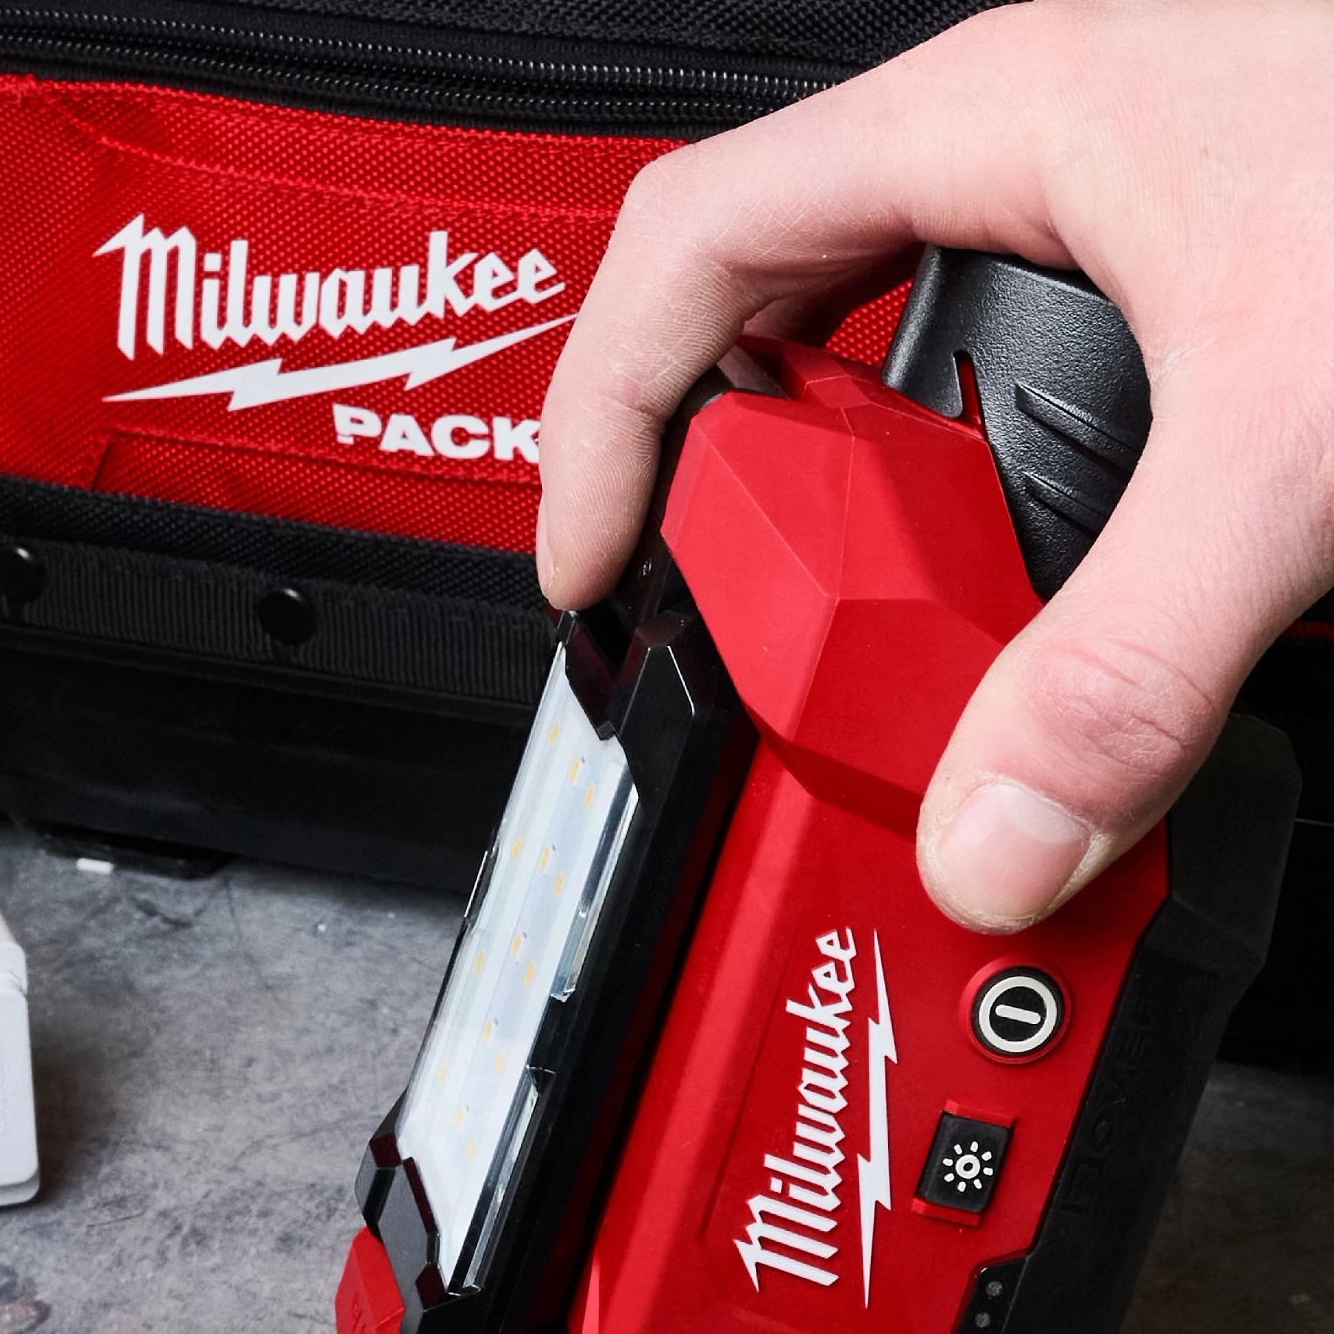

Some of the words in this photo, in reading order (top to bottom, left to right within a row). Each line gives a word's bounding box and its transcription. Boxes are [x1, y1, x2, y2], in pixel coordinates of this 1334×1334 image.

[93, 213, 567, 361] Milwaukee
[332, 403, 541, 465] PACK
[733, 926, 859, 1295] Milwaukee
